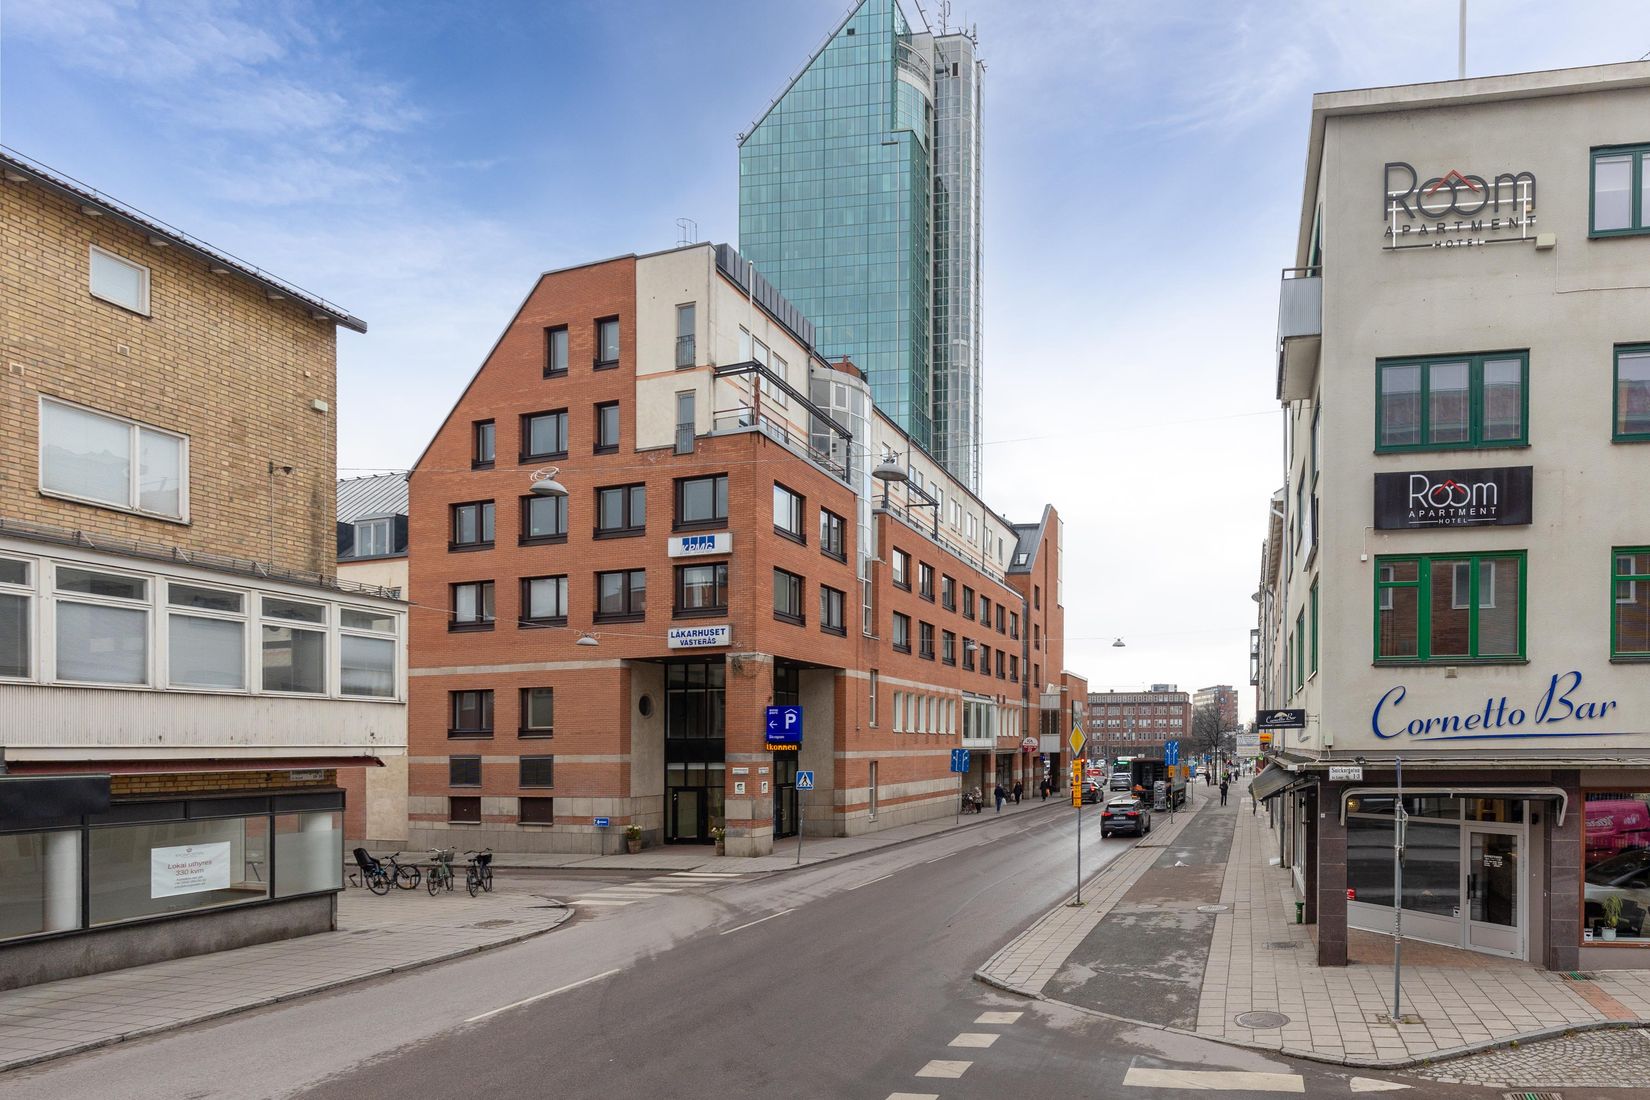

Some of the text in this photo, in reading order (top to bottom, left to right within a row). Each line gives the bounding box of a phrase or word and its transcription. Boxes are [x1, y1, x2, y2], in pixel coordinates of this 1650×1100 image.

[1384, 161, 1537, 221] Room
[1384, 215, 1537, 237] APARTMENT
[1434, 237, 1484, 249] HOTEL
[1409, 474, 1497, 508] Room
[1408, 507, 1497, 518] APARTMENT
[681, 540, 715, 554] KPMG
[670, 628, 726, 638] LÄKARHUSET
[1372, 670, 1617, 739] Cornetto Bar
[785, 713, 797, 729] P
